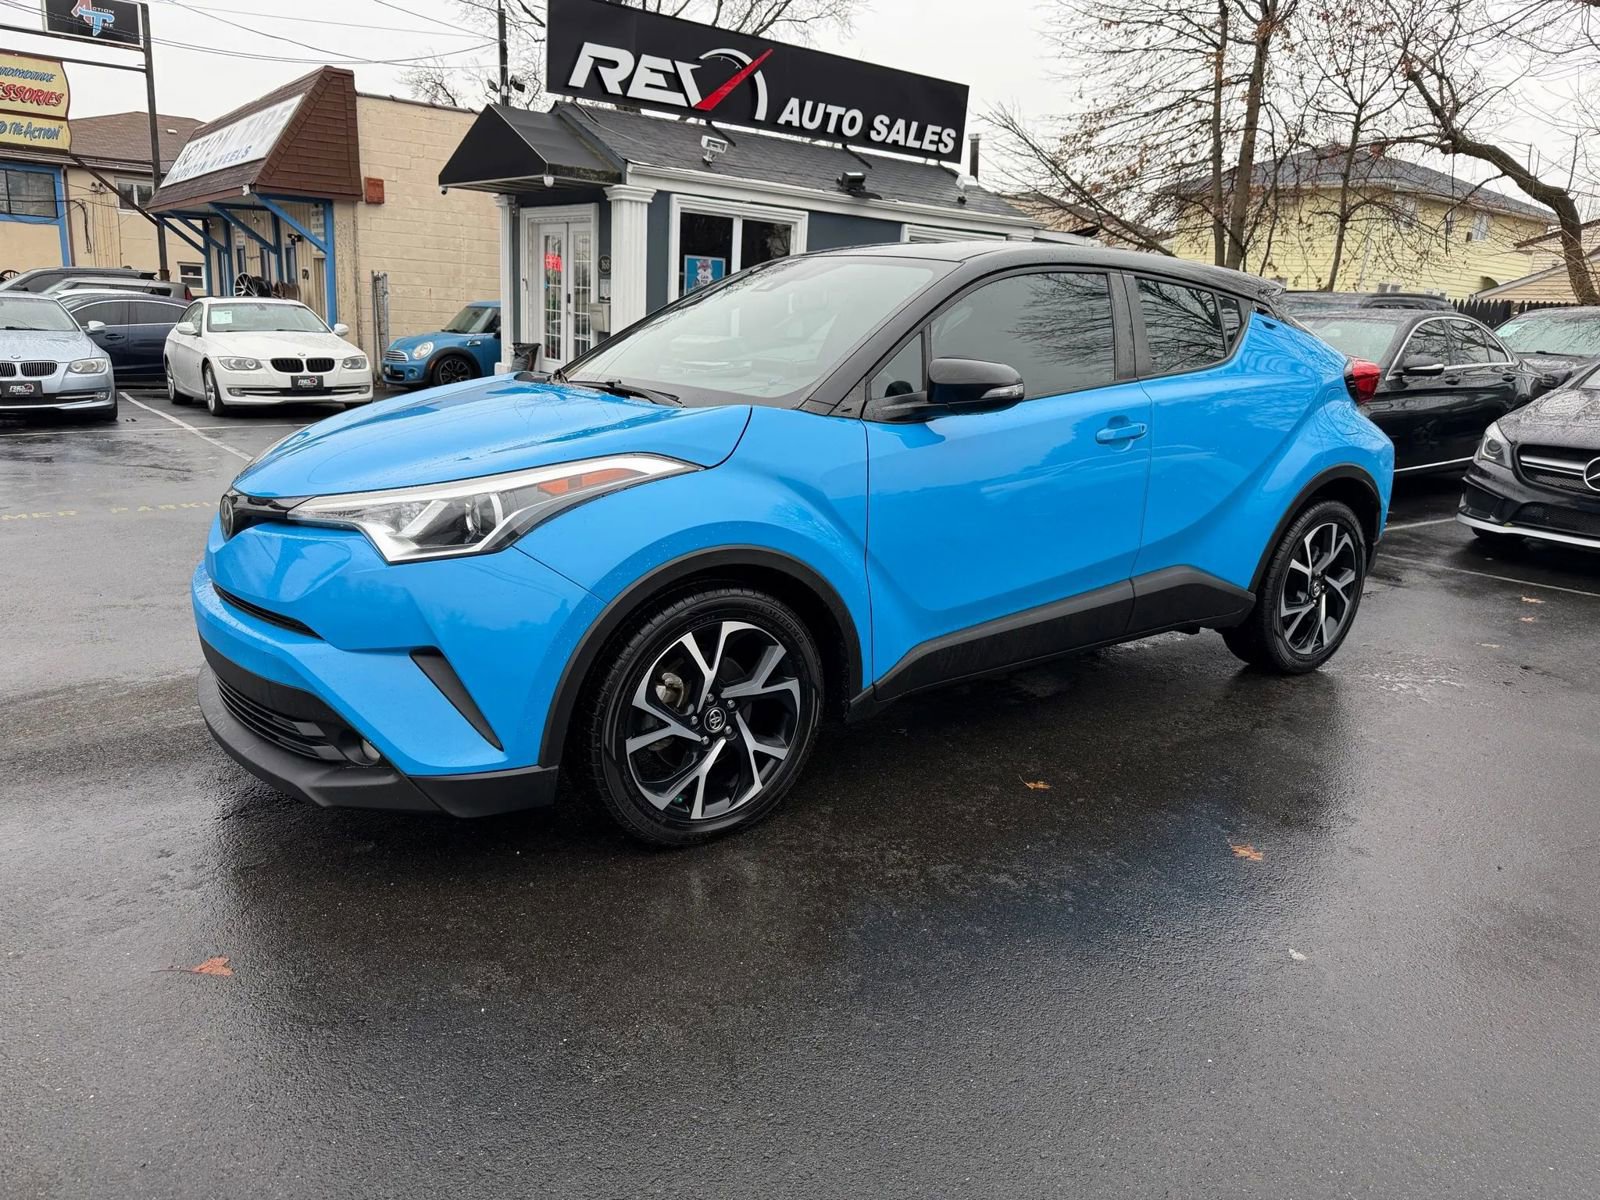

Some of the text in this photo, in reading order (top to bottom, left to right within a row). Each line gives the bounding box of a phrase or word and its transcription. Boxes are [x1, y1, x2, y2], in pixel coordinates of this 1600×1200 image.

[568, 42, 774, 112] REX
[777, 97, 956, 154] AUTO SALES
